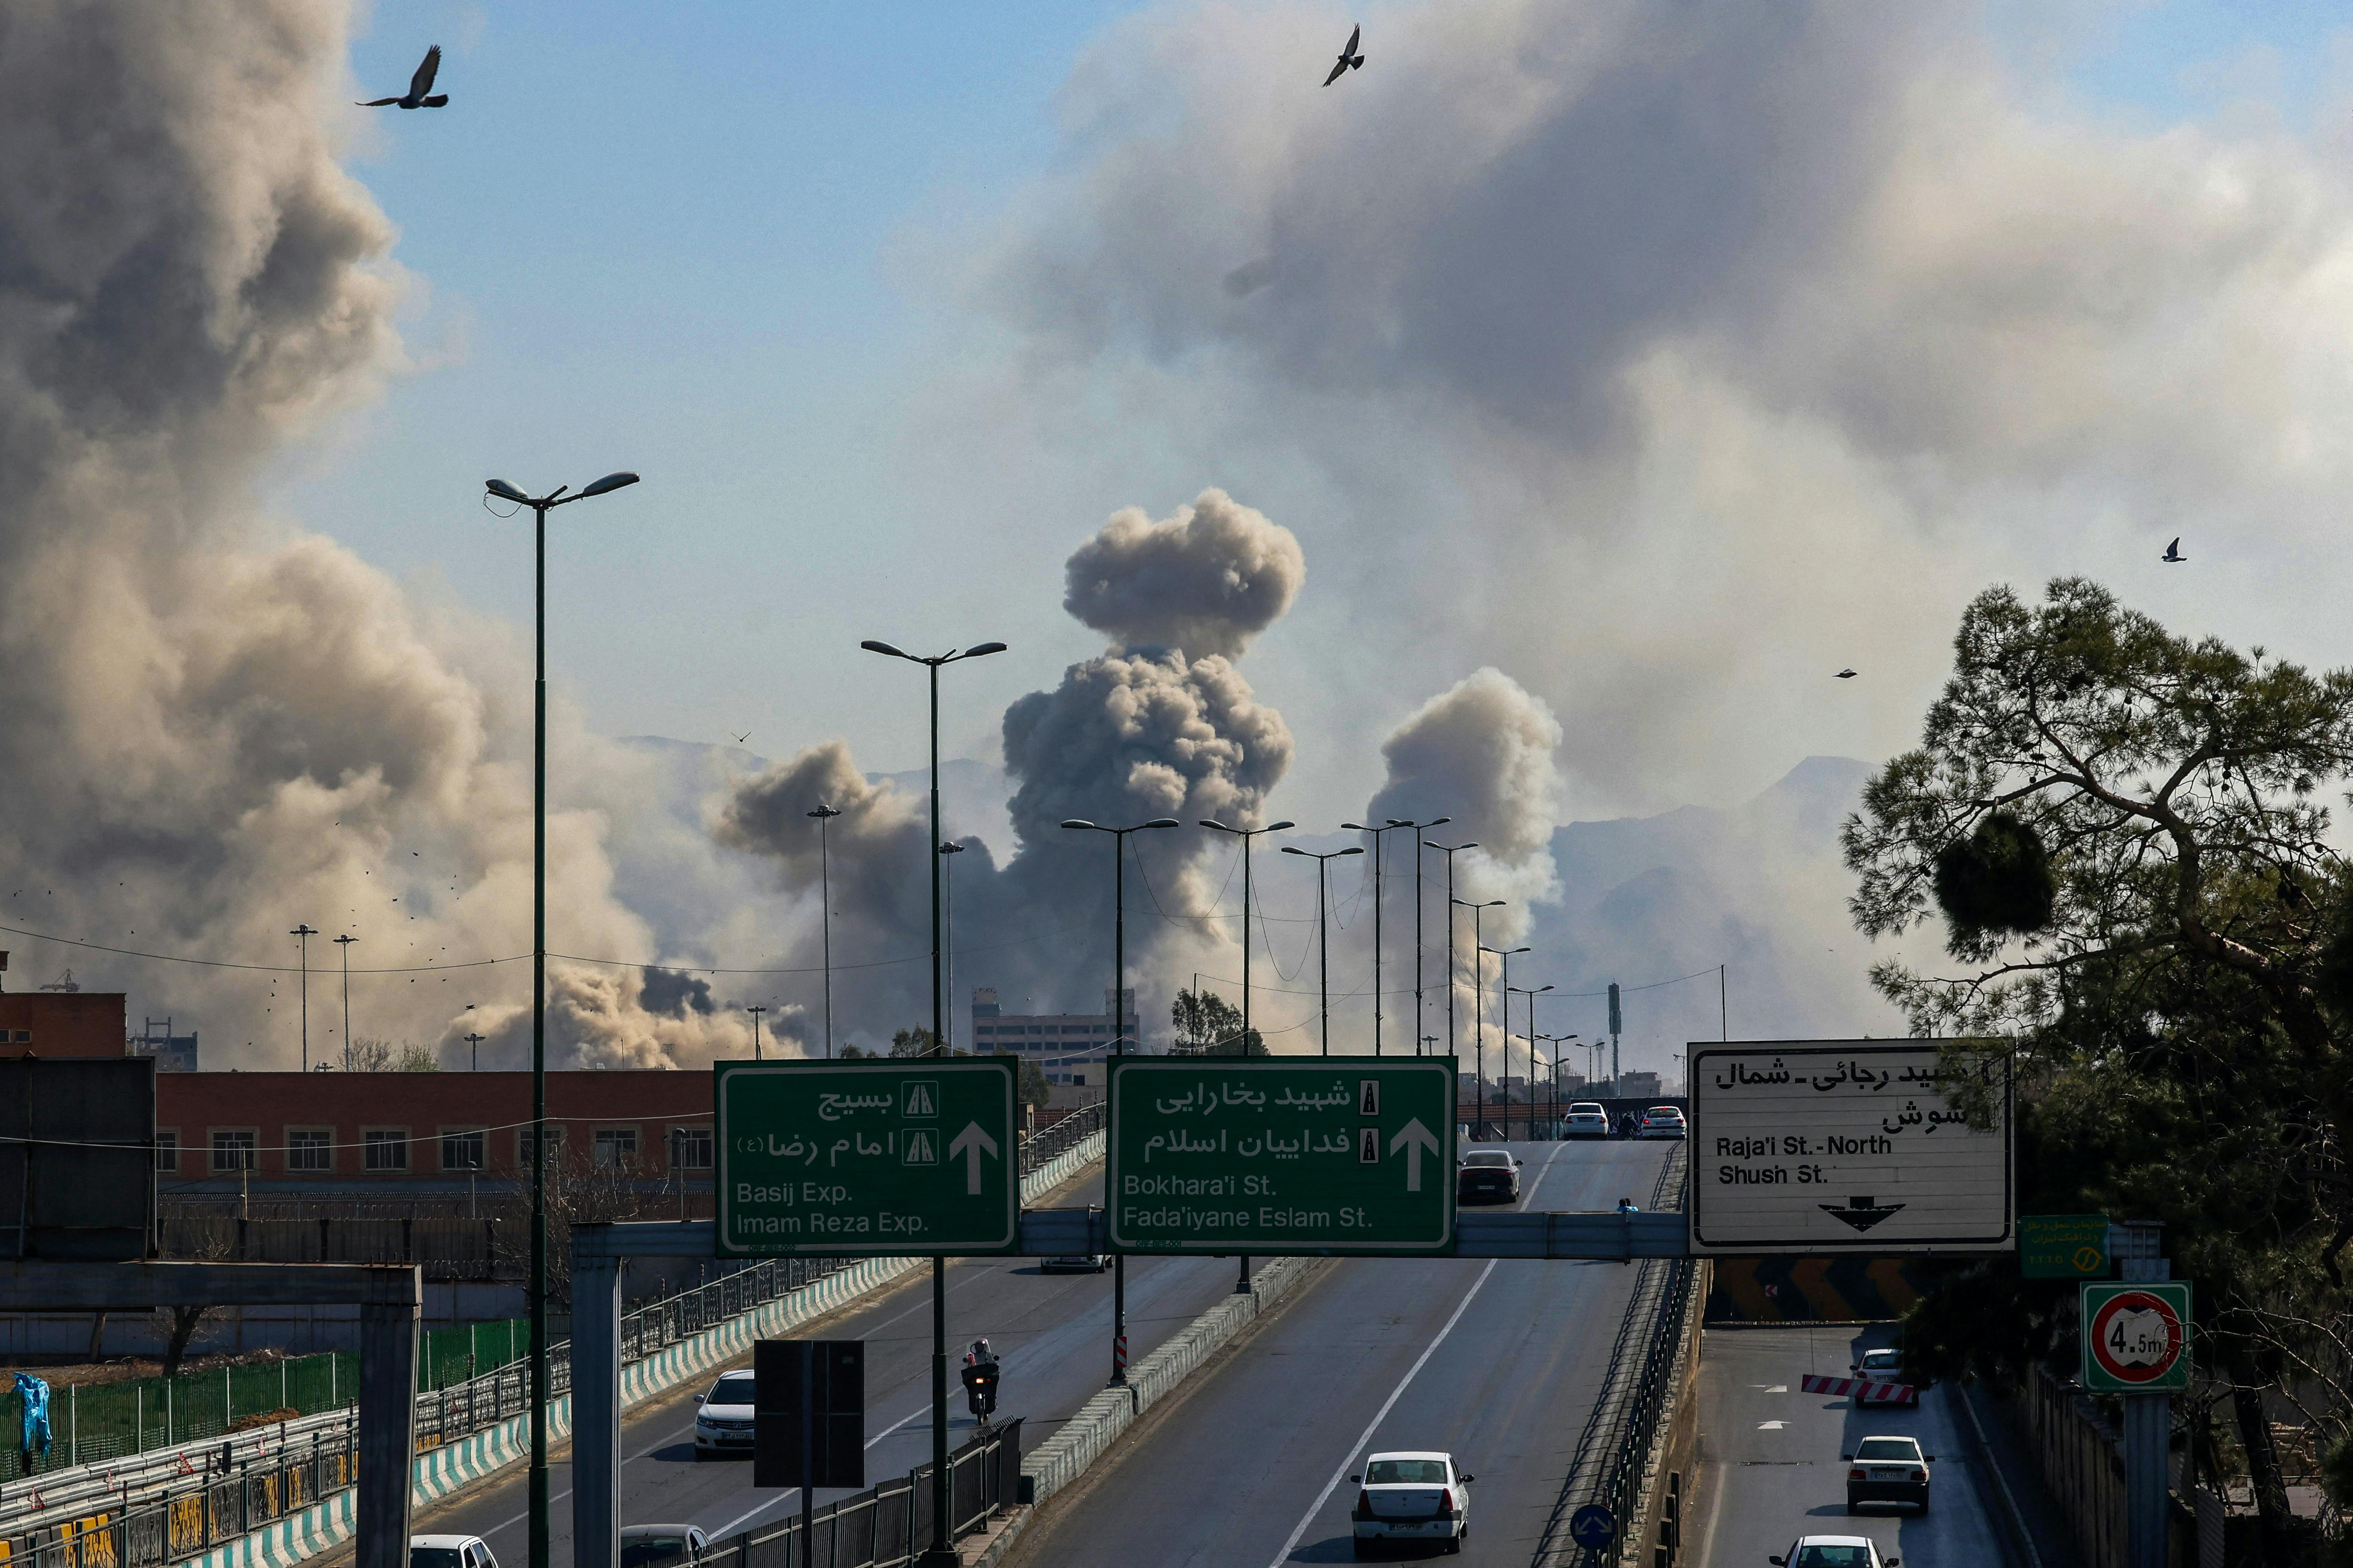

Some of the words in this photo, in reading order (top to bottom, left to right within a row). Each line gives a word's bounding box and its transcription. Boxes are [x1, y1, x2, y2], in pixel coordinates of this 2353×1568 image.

[819, 1094, 892, 1121] بسیج
[1156, 1083, 1266, 1115] بخارایی
[1275, 1081, 1350, 1111] شهید
[831, 1132, 893, 1167] امام
[1145, 1129, 1226, 1163] اسلام
[1238, 1128, 1349, 1158] فداییان
[1717, 1137, 1775, 1159] Raja'i
[1125, 1175, 1234, 1195] Bokhara'i
[1244, 1176, 1276, 1195] St.
[1719, 1165, 1787, 1184] Shush
[1797, 1165, 1827, 1183] St.
[738, 1183, 793, 1206] Basij
[803, 1182, 852, 1205] Exp.
[738, 1214, 800, 1233] Imam
[811, 1213, 869, 1232] Reza
[879, 1212, 928, 1235] Exp.
[1125, 1207, 1249, 1230] Fada'iyane
[1260, 1207, 1329, 1227] Eslam
[1340, 1207, 1372, 1227] St.
[2110, 1322, 2162, 1353] 4.5m
